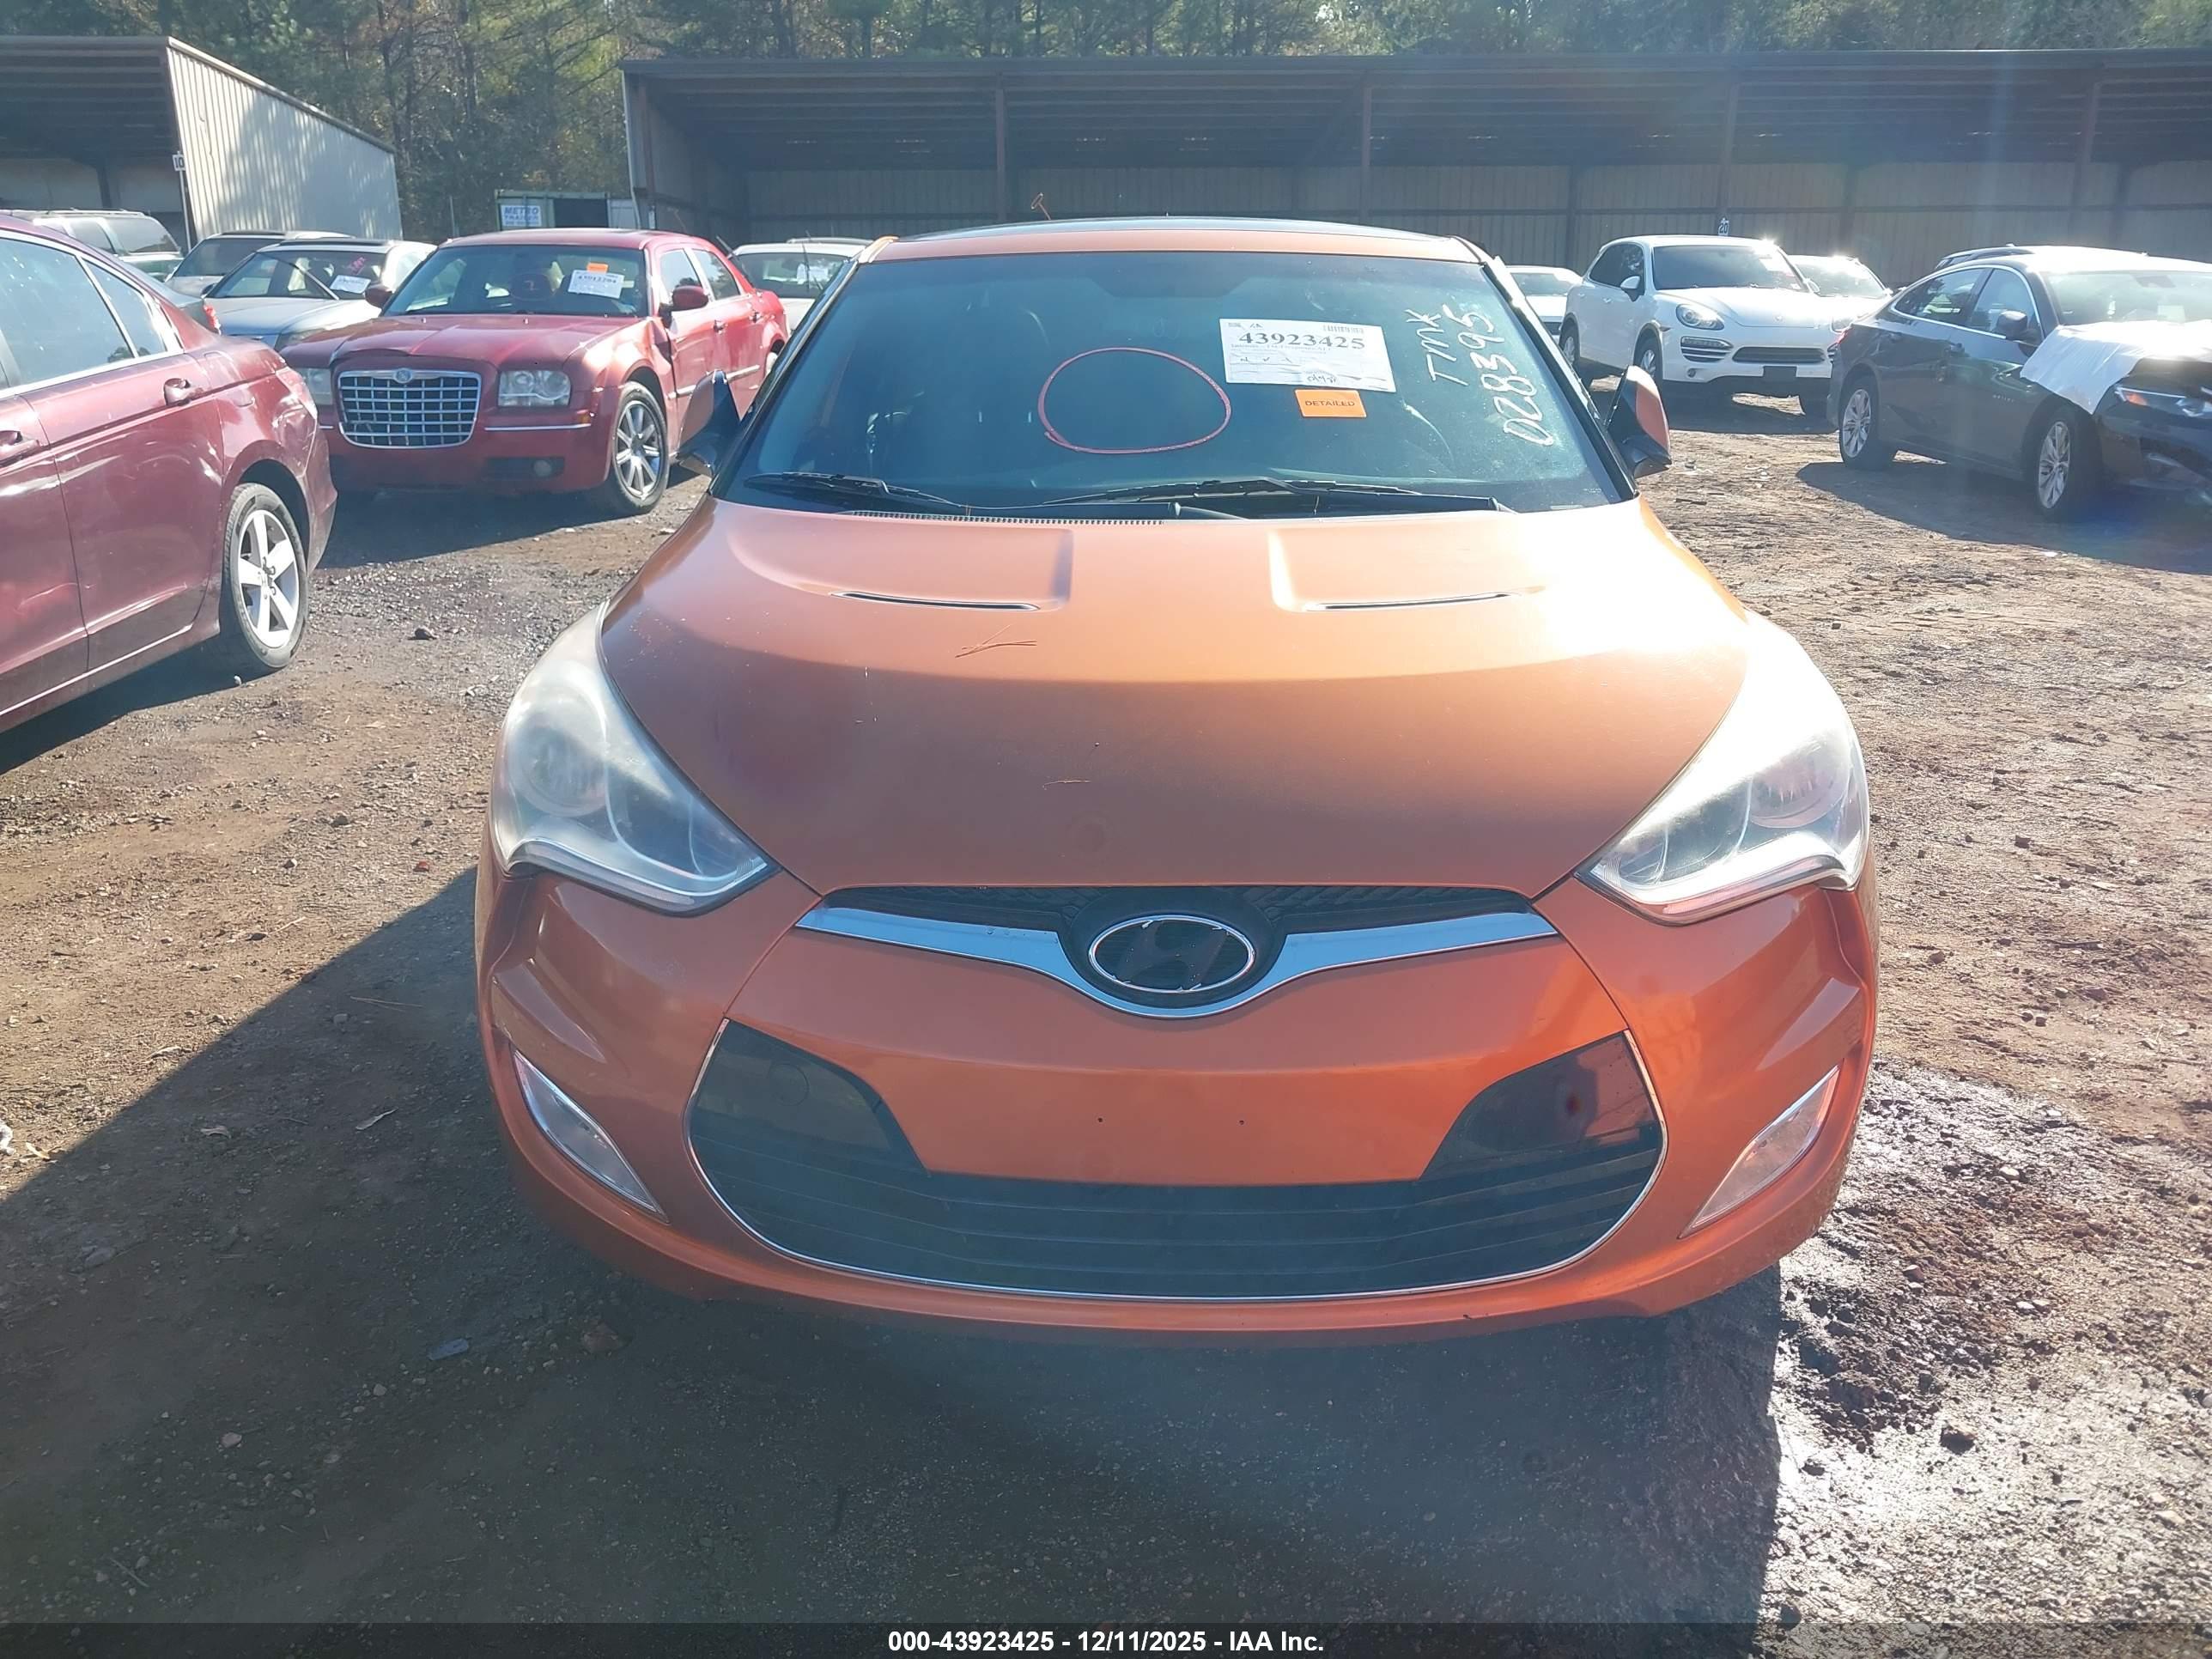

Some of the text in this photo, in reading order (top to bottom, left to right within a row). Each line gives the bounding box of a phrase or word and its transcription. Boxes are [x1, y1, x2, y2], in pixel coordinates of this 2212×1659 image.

[174, 156, 185, 168] 10
[1719, 222, 1729, 234] 20
[1239, 332, 1365, 349] 43923425
[1442, 303, 1553, 446] 028395
